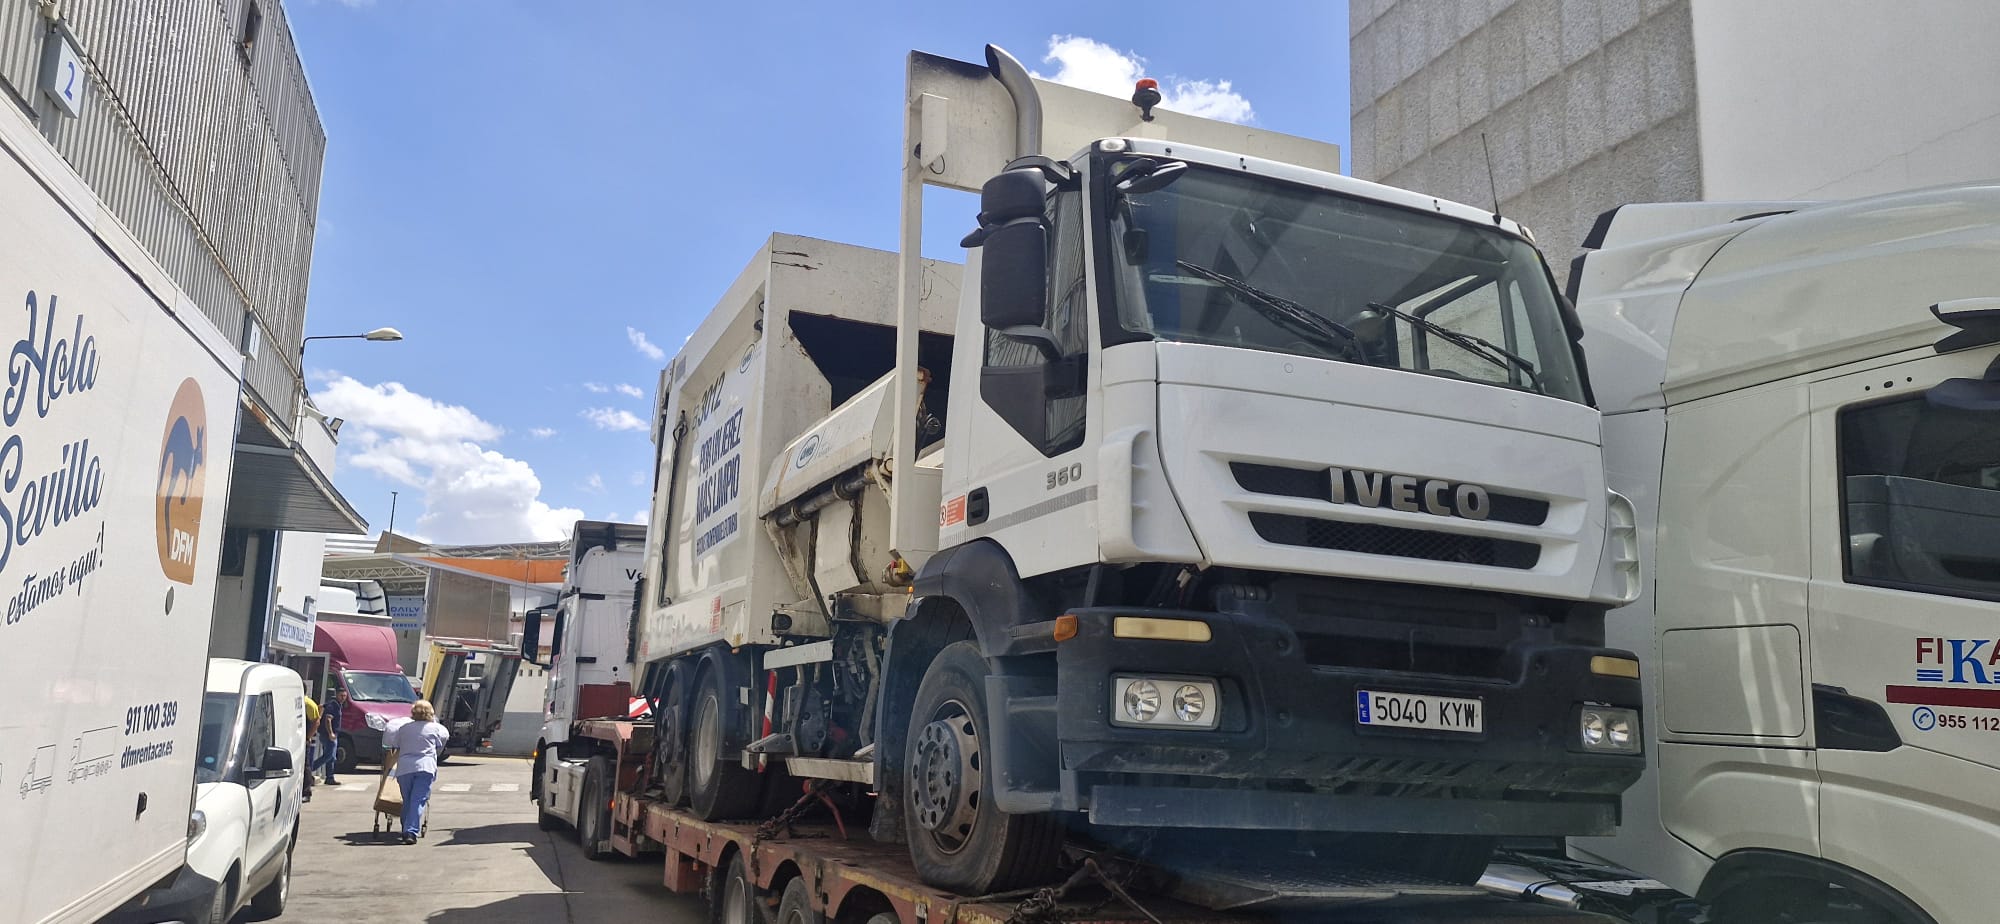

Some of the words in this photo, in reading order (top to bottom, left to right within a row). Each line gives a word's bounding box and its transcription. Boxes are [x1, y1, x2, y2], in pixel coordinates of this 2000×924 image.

[64, 61, 74, 100] 2
[2, 289, 100, 427] Hola
[719, 406, 744, 458] JEREZ
[712, 453, 741, 514] LIMPIO
[1046, 462, 1082, 491] 360
[1329, 466, 1490, 521] IVECO
[0, 434, 105, 575] Sevilla
[170, 528, 195, 566] DFM
[6, 571, 66, 626] estamos
[125, 706, 142, 736] 911
[142, 703, 160, 731] 100
[160, 701, 178, 728] 389
[1375, 696, 1427, 724] 5040
[1439, 701, 1475, 728] KYW
[1938, 714, 1967, 729] 955
[1972, 716, 2000, 731] 112
[120, 740, 174, 769] dfmrentacar.es
